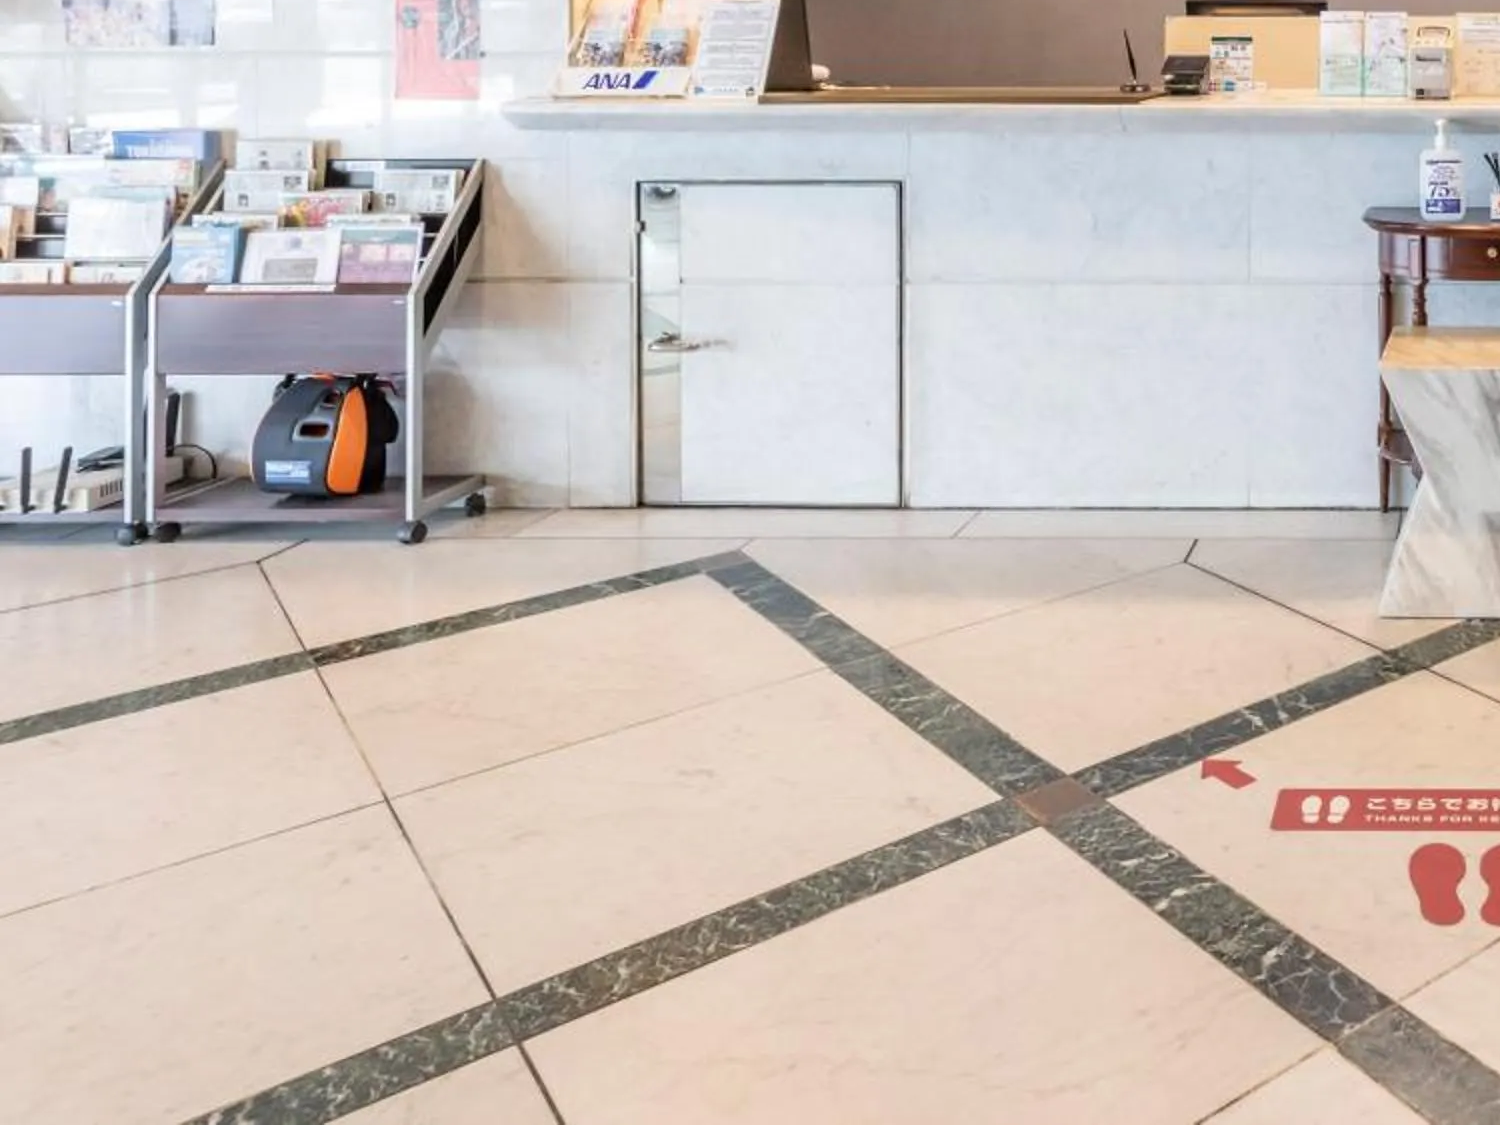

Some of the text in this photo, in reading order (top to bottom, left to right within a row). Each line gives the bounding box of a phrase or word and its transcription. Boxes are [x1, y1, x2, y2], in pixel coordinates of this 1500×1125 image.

[583, 73, 631, 90] ANA
[1365, 814, 1433, 823] THANKS
[1440, 814, 1472, 823] FOR
